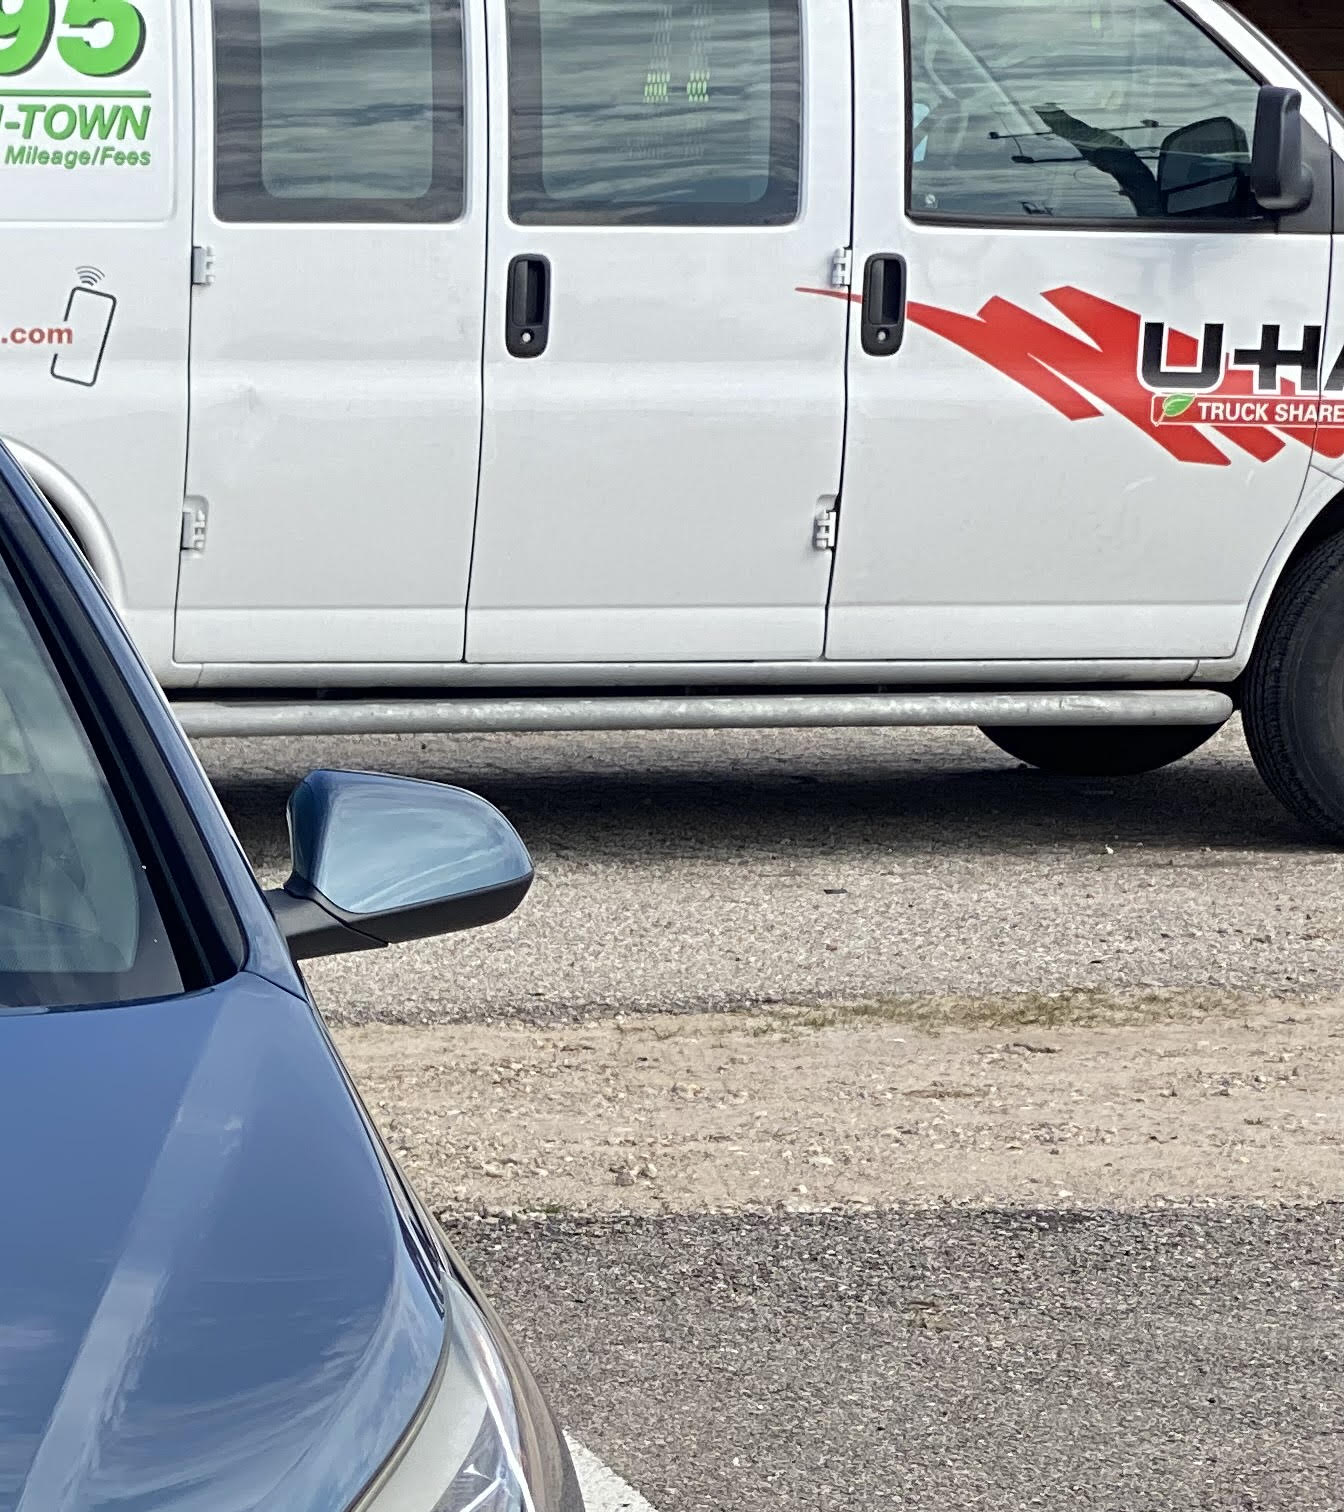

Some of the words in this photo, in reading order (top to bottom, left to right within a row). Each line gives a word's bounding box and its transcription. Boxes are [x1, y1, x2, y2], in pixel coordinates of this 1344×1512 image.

[4, 145, 152, 170] Mileage/Fees
[1197, 402, 1269, 422] TRUCK
[1274, 404, 1344, 423] SHARE
